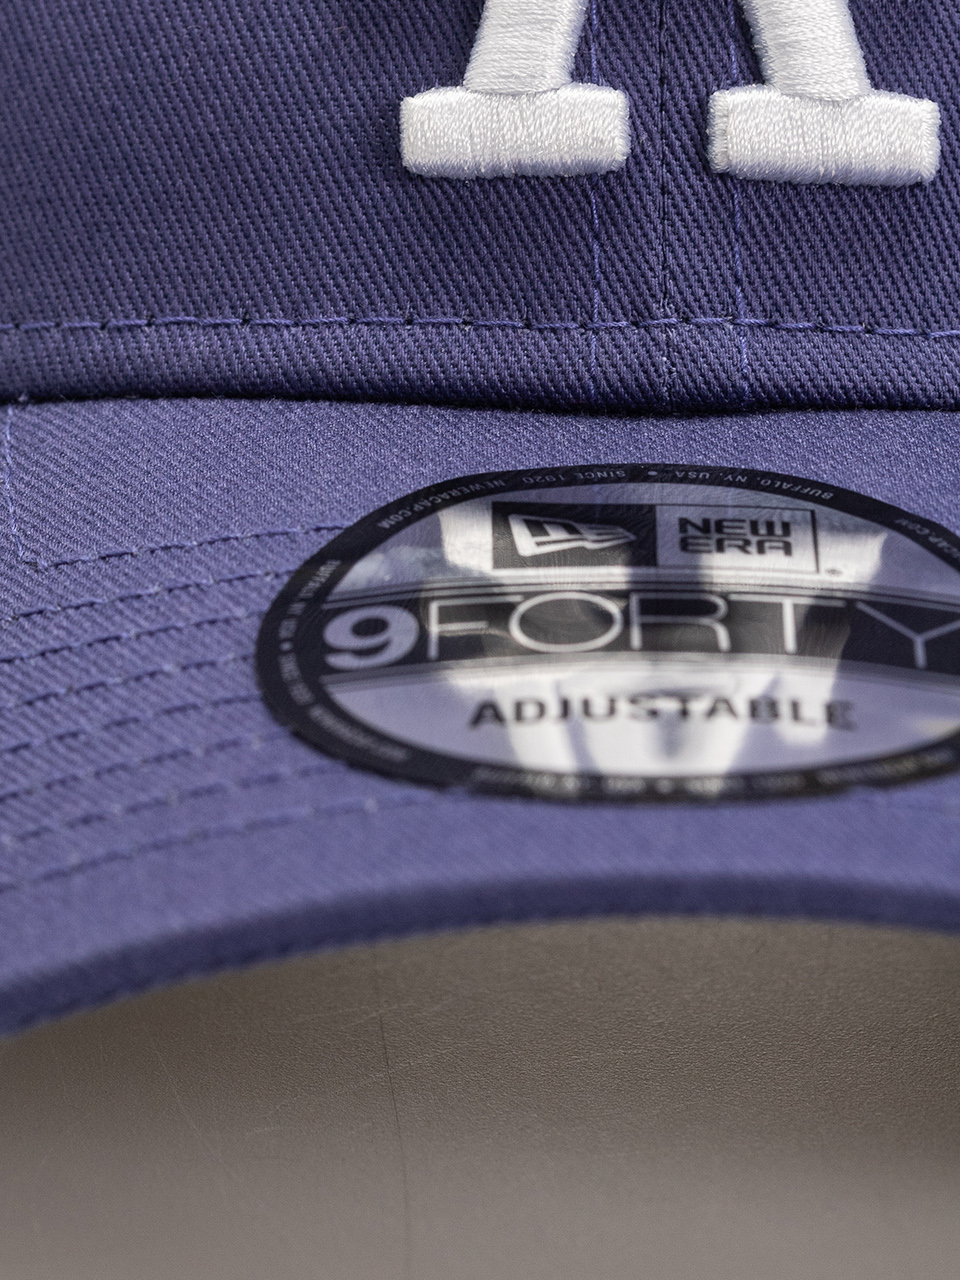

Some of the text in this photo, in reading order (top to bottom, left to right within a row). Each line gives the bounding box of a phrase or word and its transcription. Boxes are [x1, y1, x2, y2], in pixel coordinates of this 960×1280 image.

[522, 473, 566, 484] 1920
[574, 470, 626, 480] SINCE
[675, 470, 710, 480] USA
[376, 479, 507, 529] NEWERACAP.COM
[678, 517, 791, 537] NEW
[679, 536, 793, 556] ERA
[323, 590, 960, 670] 9FORTY
[470, 692, 855, 731] ADJUSTABLE
